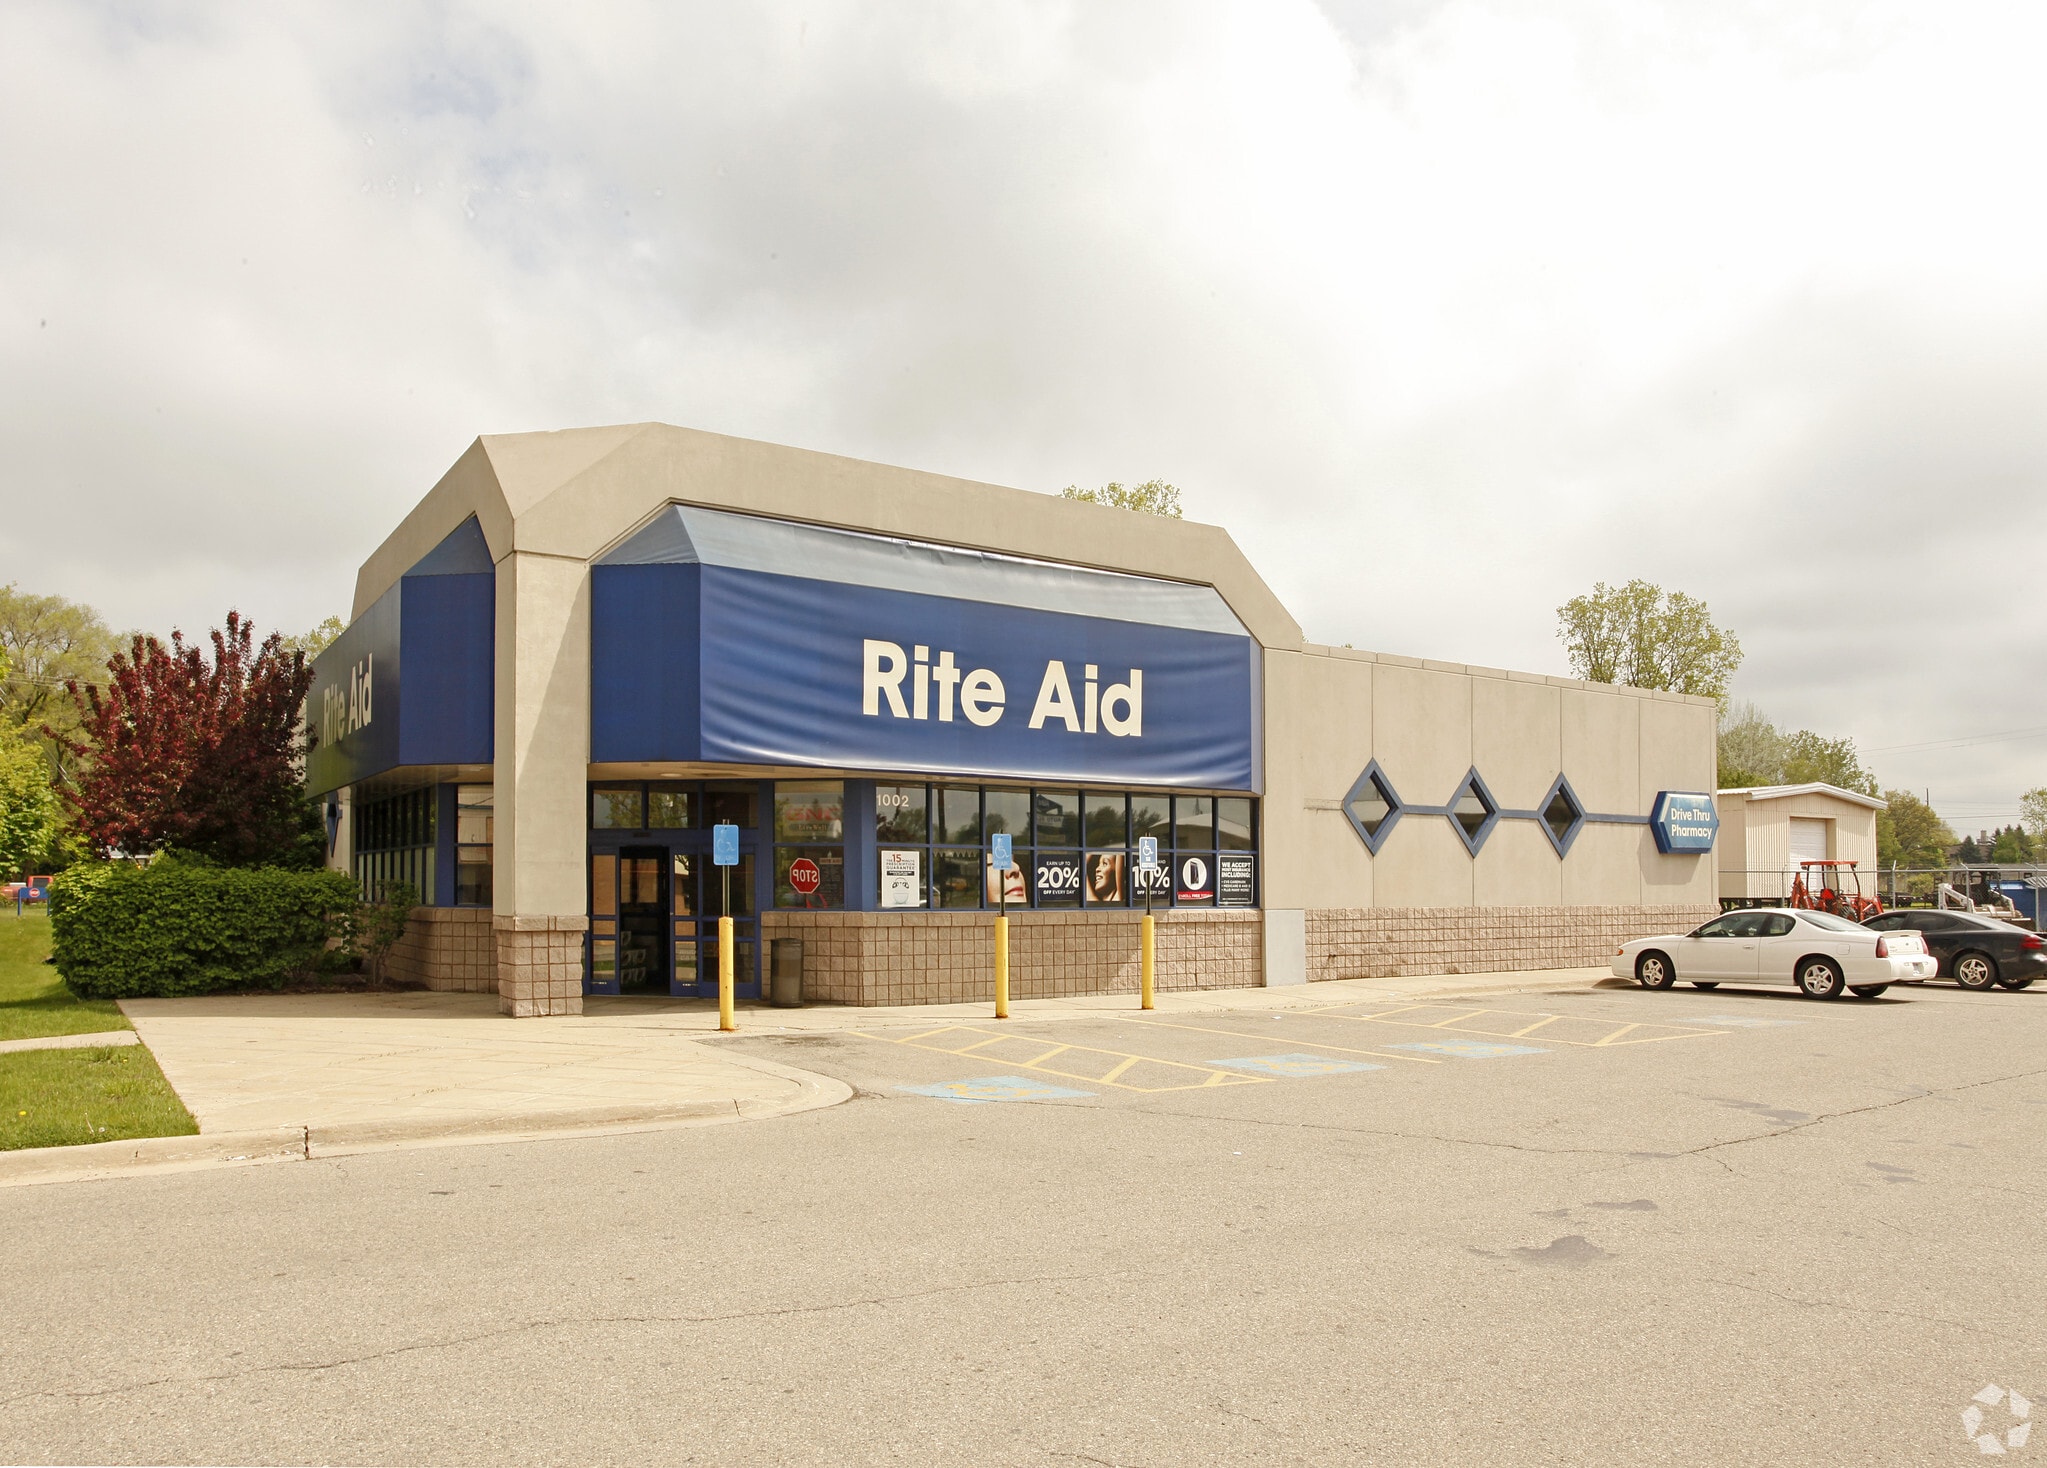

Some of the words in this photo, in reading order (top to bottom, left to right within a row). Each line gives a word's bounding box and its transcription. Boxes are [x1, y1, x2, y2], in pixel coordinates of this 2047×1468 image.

[863, 638, 1006, 727] Rite
[1028, 660, 1143, 737] Aid
[323, 683, 346, 749] Rite
[348, 653, 372, 735] Aid
[877, 794, 909, 807] 1002
[786, 808, 841, 821] GNC
[1671, 808, 1692, 820] Drive
[1693, 808, 1710, 822] Thru
[1671, 824, 1713, 840] Pharmacy
[892, 853, 902, 863] 15
[1037, 866, 1080, 888] 20%
[1132, 866, 1170, 888] 10%
